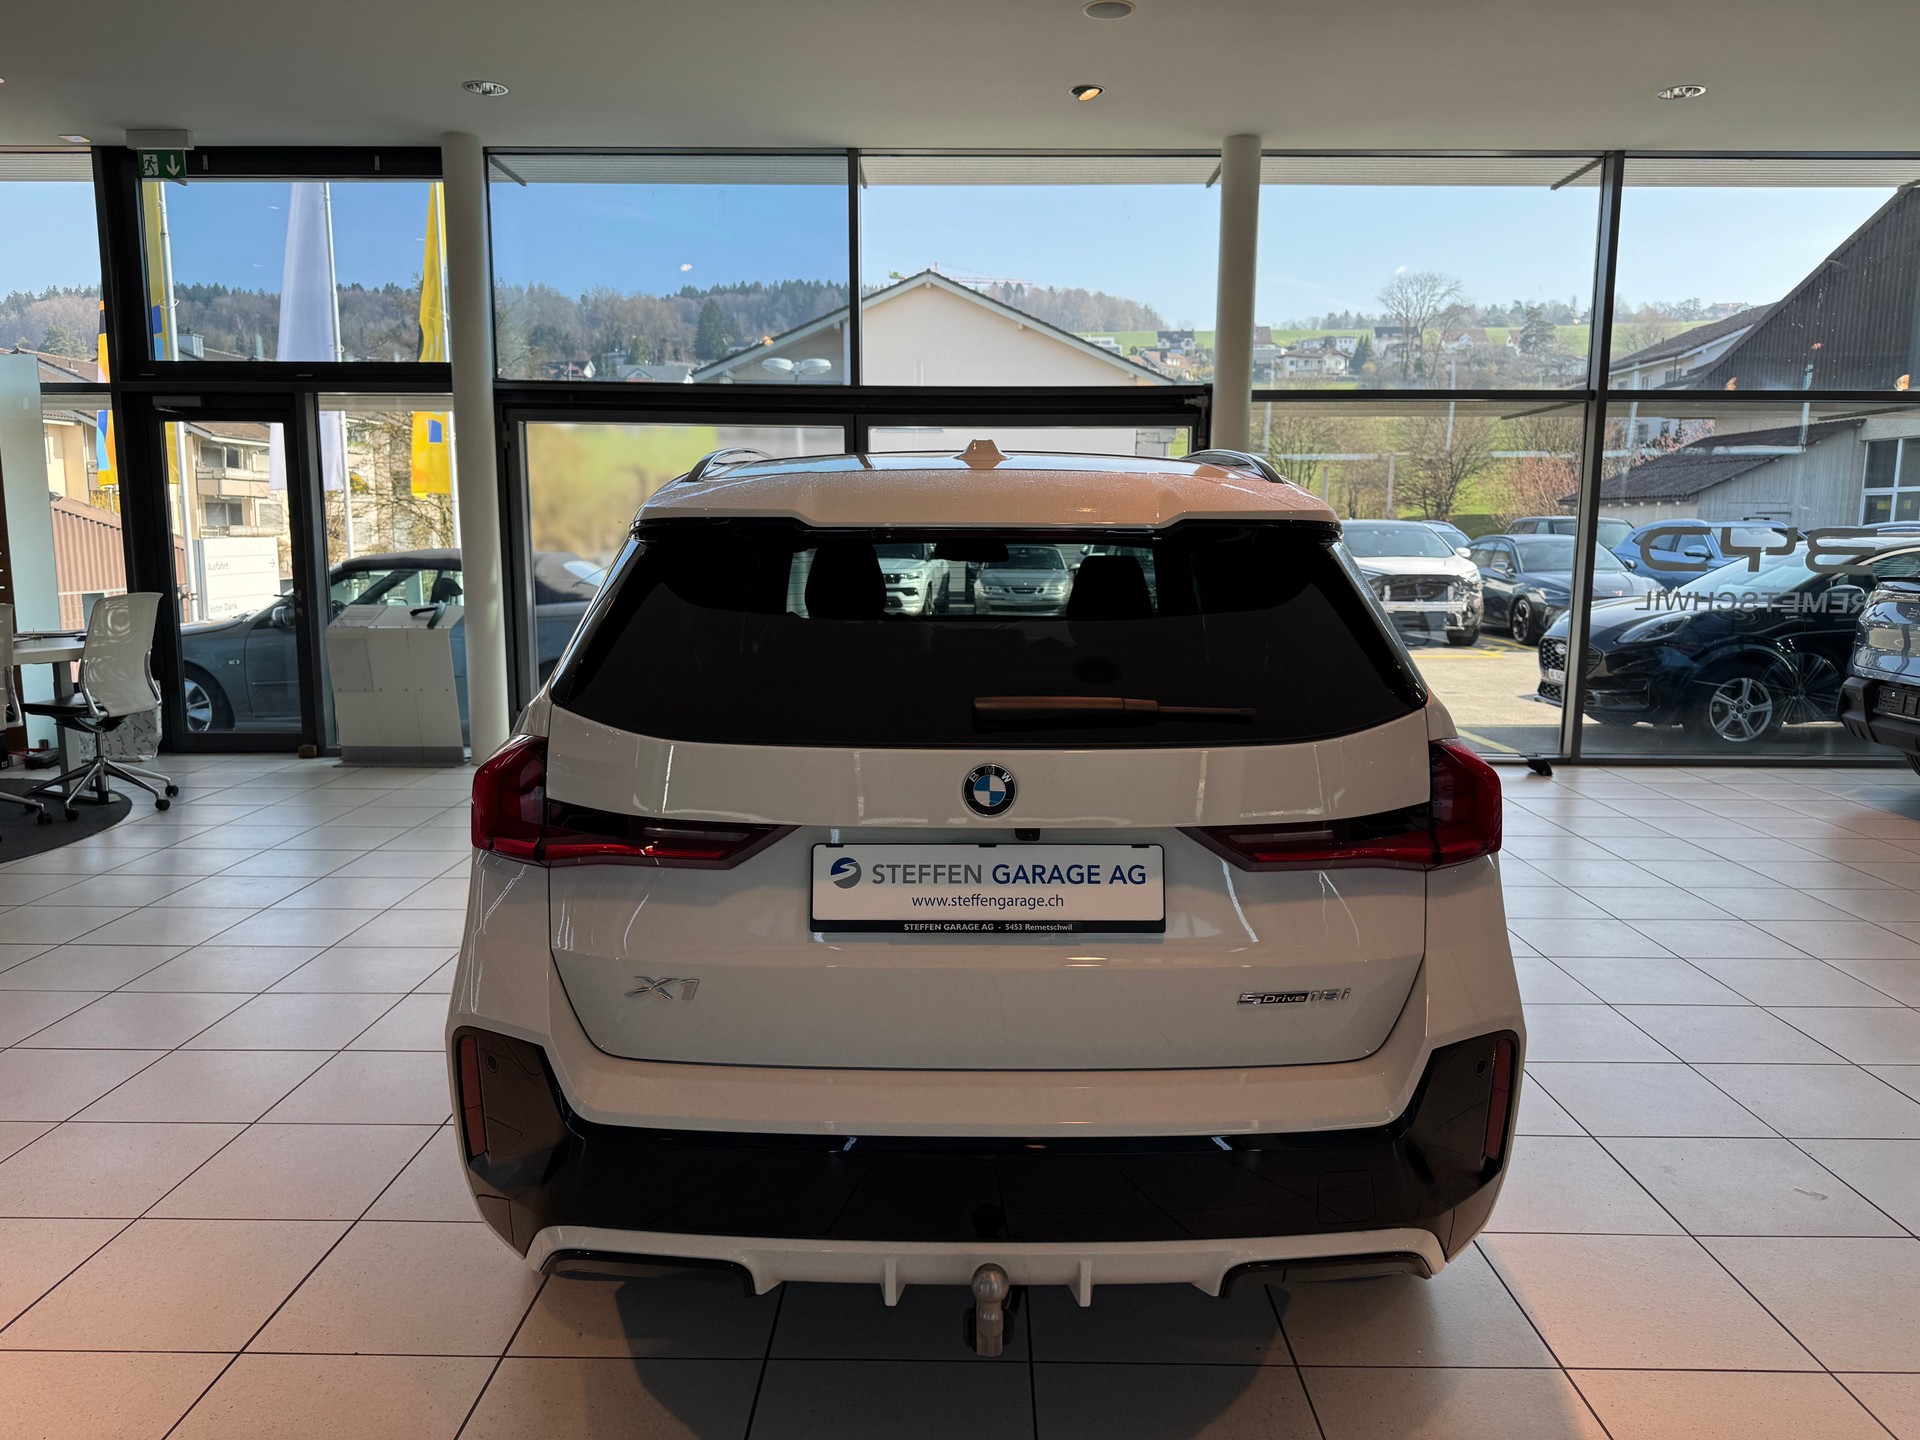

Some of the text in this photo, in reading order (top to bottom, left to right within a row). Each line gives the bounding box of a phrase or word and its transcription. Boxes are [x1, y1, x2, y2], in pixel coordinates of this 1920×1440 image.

[969, 766, 1012, 783] BMW
[871, 863, 1146, 885] STEFFEN GARAGE AG
[911, 893, 1064, 910] www.steffengarage.ch
[903, 923, 941, 931] STEFFEN
[943, 923, 980, 931] GARAGE
[981, 923, 994, 931] AG
[1005, 923, 1023, 931] 5453
[1024, 923, 1073, 931] Remetschwil
[624, 976, 700, 1001] X1
